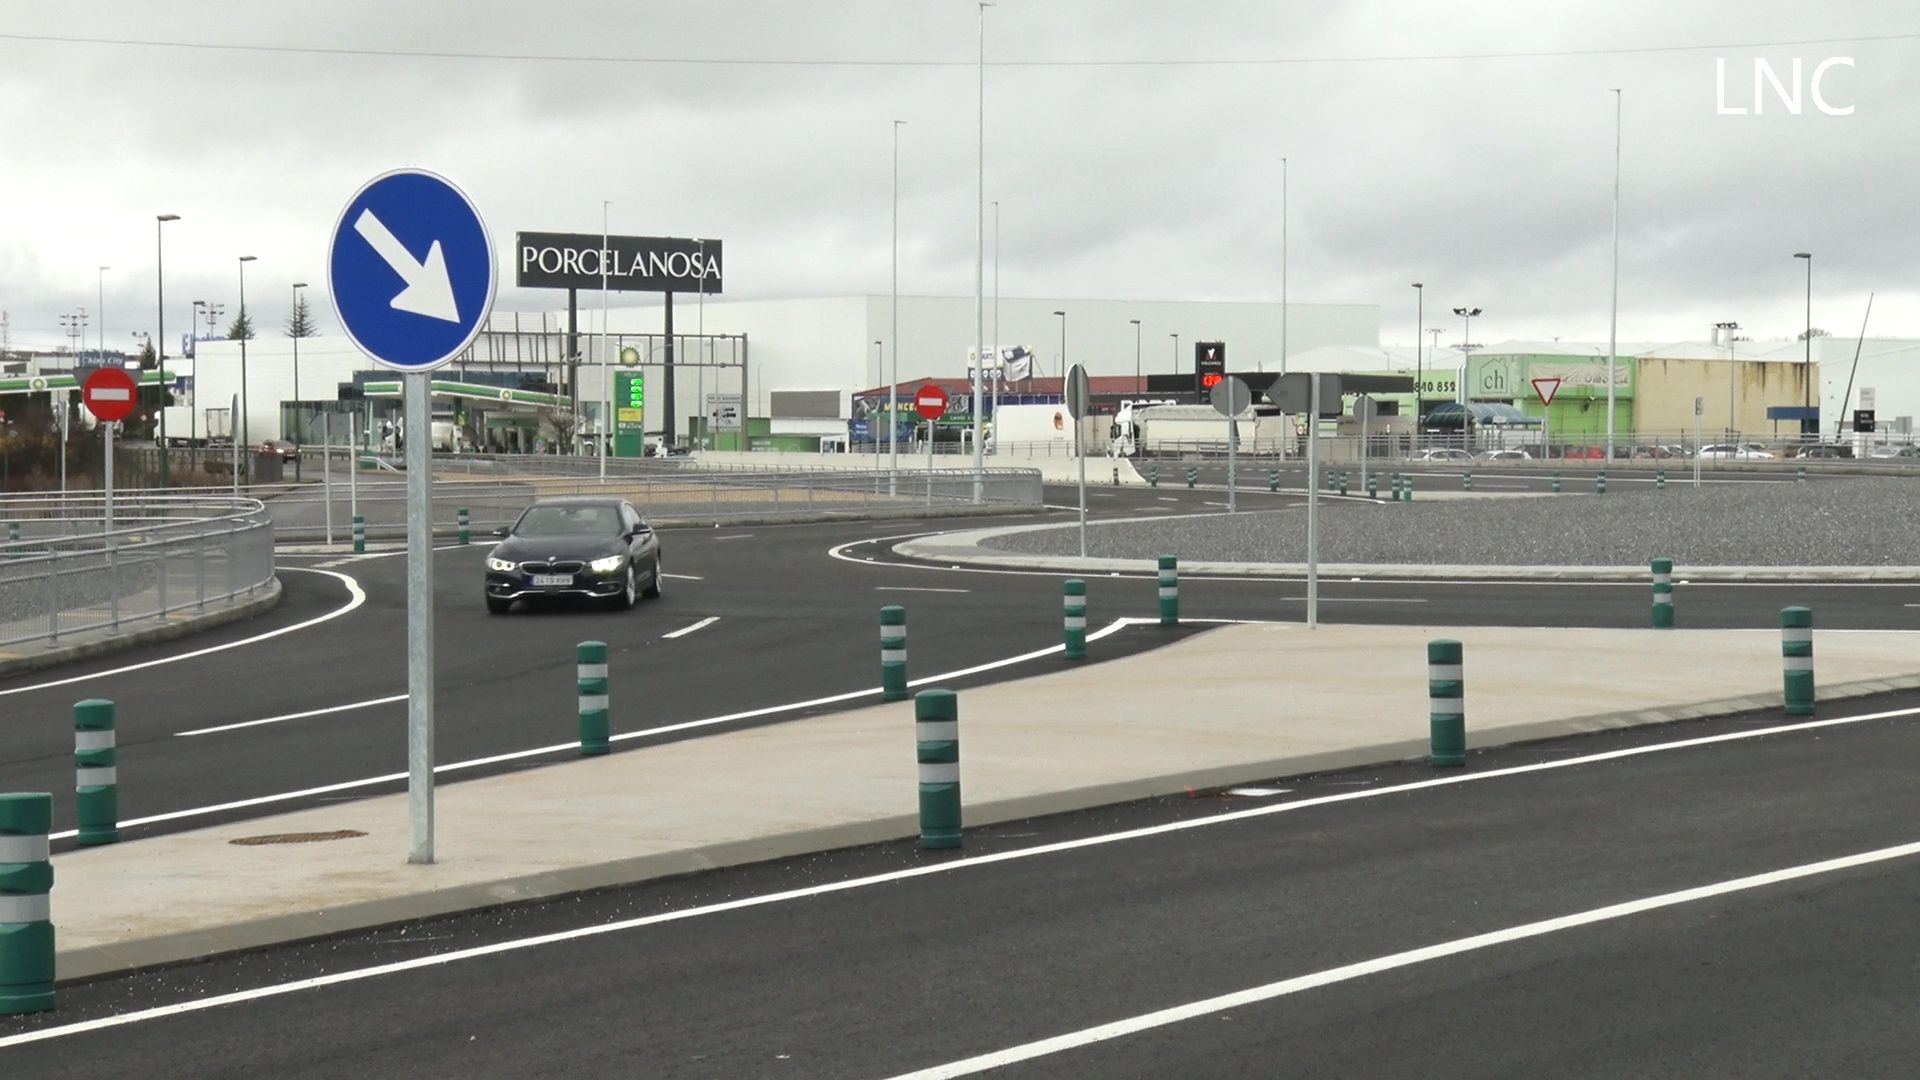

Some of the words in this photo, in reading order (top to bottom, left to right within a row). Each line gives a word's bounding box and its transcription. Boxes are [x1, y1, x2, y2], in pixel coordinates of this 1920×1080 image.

[521, 246, 721, 280] PORCELANOSA
[1437, 381, 1456, 392] 852
[1483, 369, 1504, 390] ch
